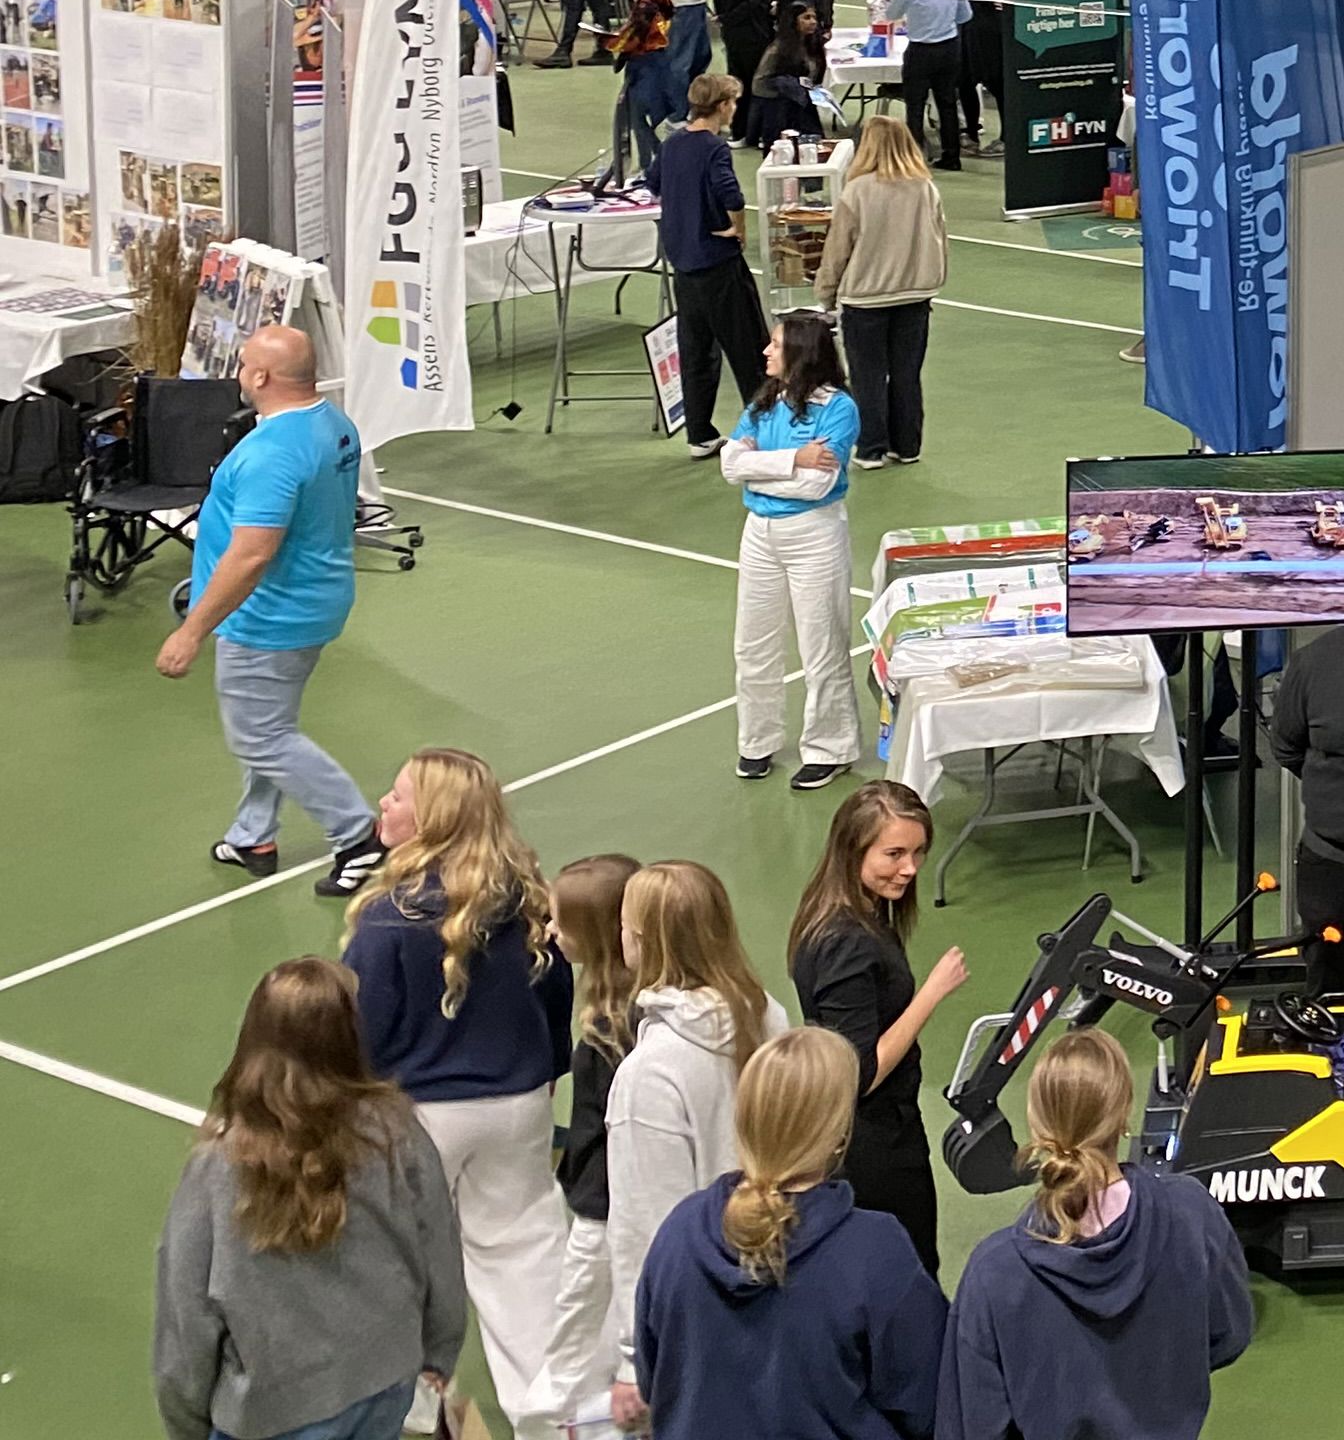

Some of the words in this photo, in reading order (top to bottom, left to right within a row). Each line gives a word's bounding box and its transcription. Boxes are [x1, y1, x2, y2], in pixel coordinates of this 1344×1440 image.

[419, 56, 444, 121] Nyborg
[1032, 121, 1068, 142] FH
[1074, 119, 1107, 136] FYN
[424, 334, 443, 393] Assens
[1102, 968, 1173, 1006] VOLVO
[1209, 1165, 1327, 1202] MUNCK
